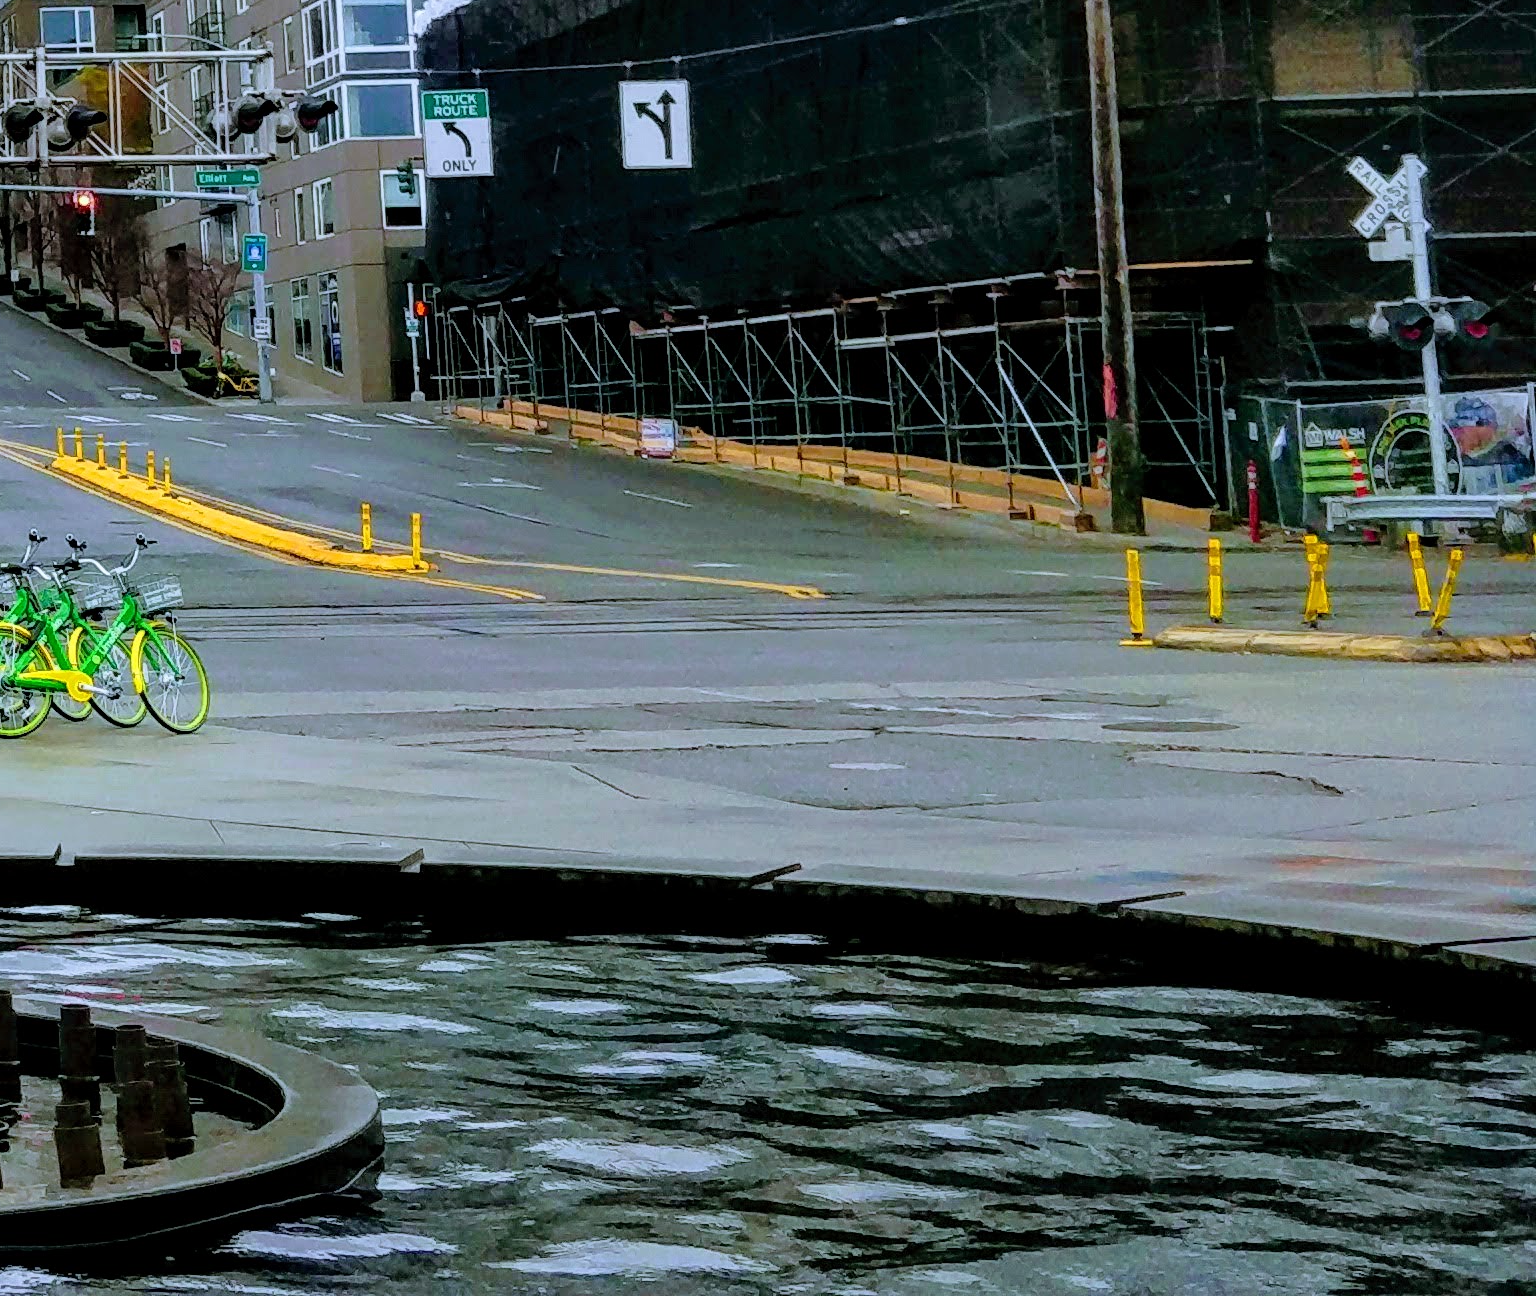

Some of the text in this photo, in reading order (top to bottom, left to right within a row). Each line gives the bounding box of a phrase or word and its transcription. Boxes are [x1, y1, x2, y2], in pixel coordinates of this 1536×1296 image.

[432, 94, 478, 106] TRUCK
[433, 104, 479, 117] ROUTE
[442, 160, 477, 172] ONLY
[1322, 427, 1366, 441] WALSH
